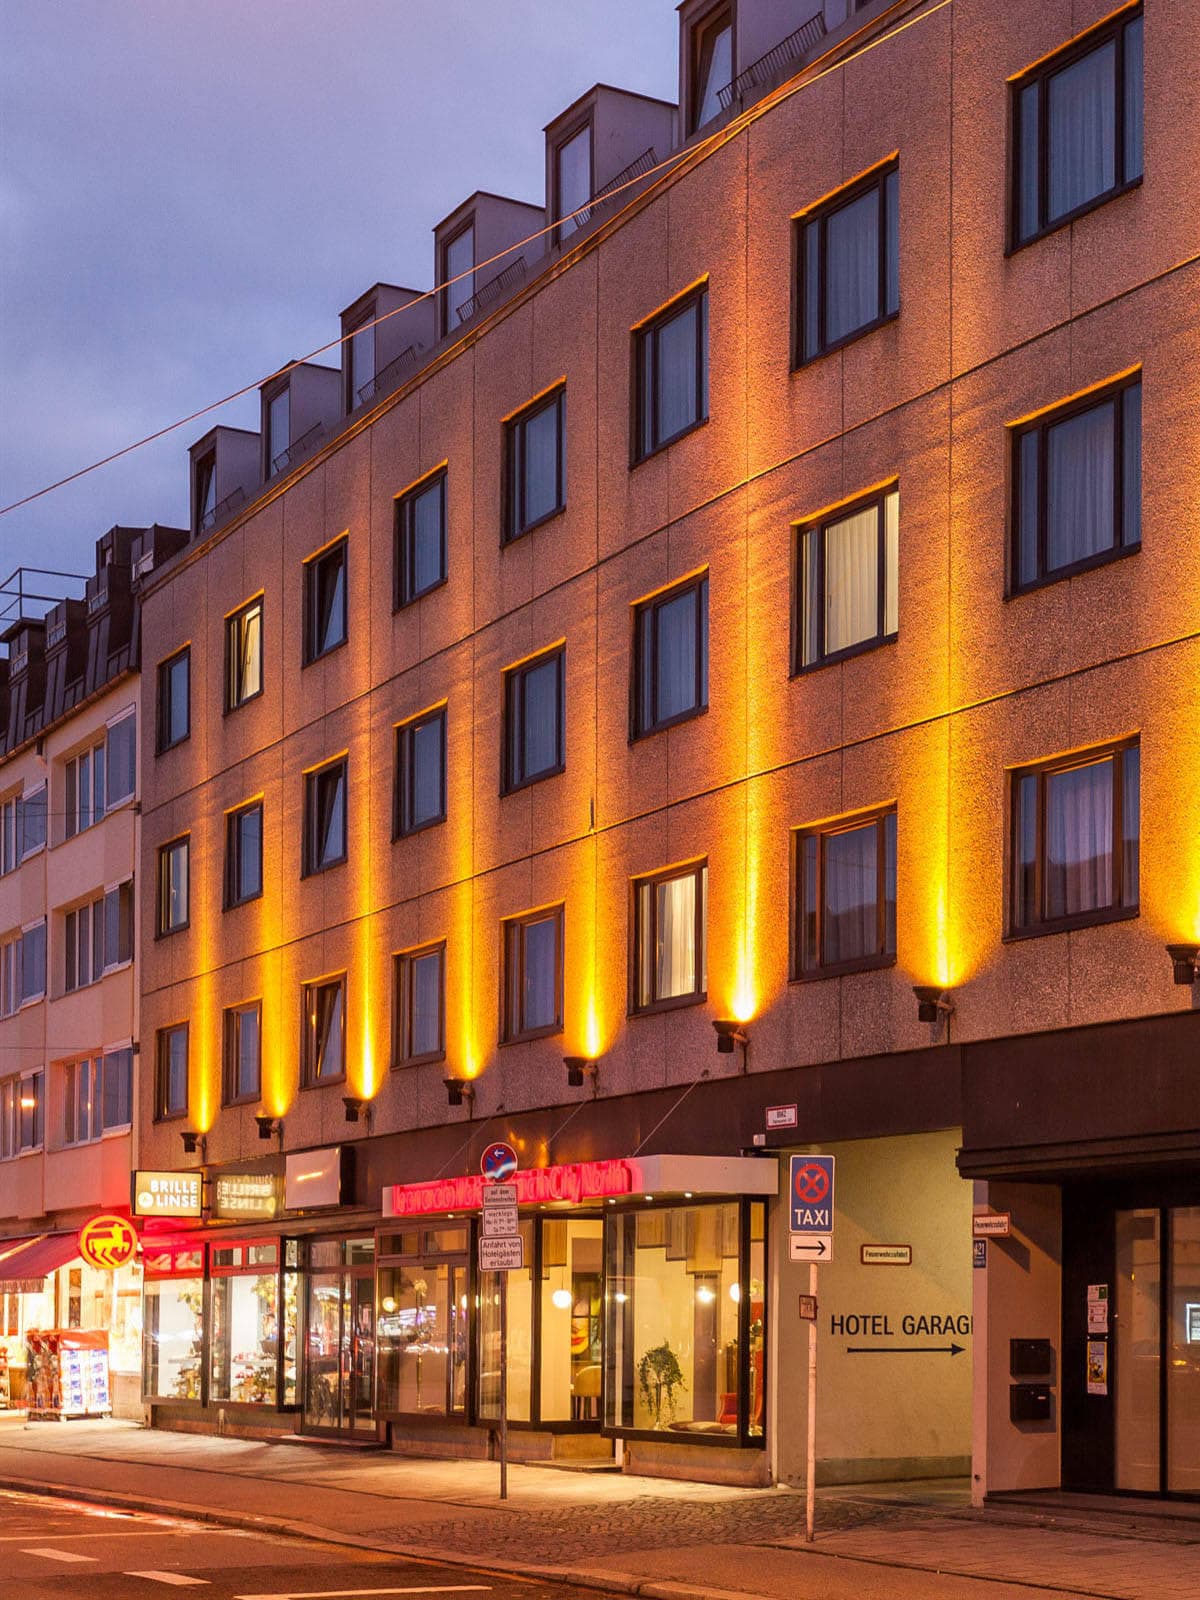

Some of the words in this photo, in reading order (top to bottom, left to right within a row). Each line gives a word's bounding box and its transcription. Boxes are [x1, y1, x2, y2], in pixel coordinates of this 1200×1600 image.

[150, 1179, 198, 1194] BRILLE
[156, 1194, 198, 1208] LINSE
[795, 1209, 829, 1226] TAXI
[831, 1314, 894, 1335] HOTEL
[902, 1314, 974, 1336] GARAG
